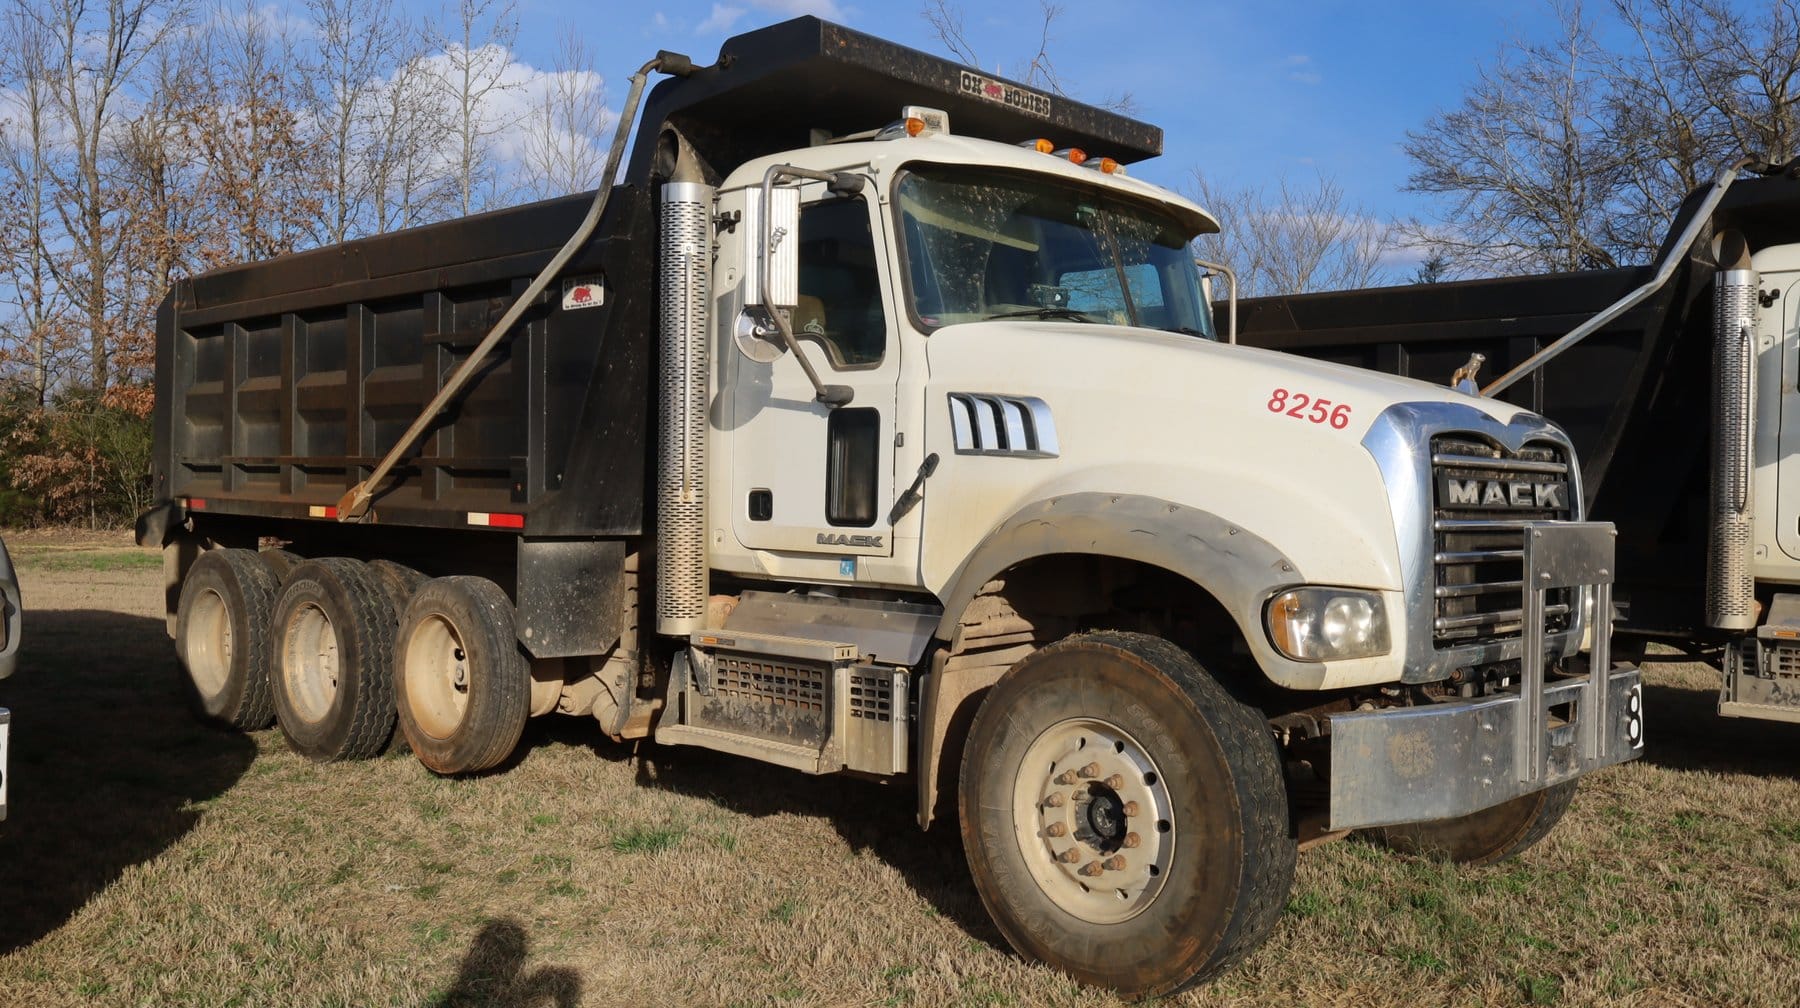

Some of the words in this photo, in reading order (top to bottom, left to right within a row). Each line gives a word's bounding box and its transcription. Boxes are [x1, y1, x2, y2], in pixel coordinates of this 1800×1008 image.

[962, 73, 982, 95] OX
[1267, 388, 1352, 429] 8256
[1449, 480, 1561, 507] MACK
[816, 533, 884, 547] MACK
